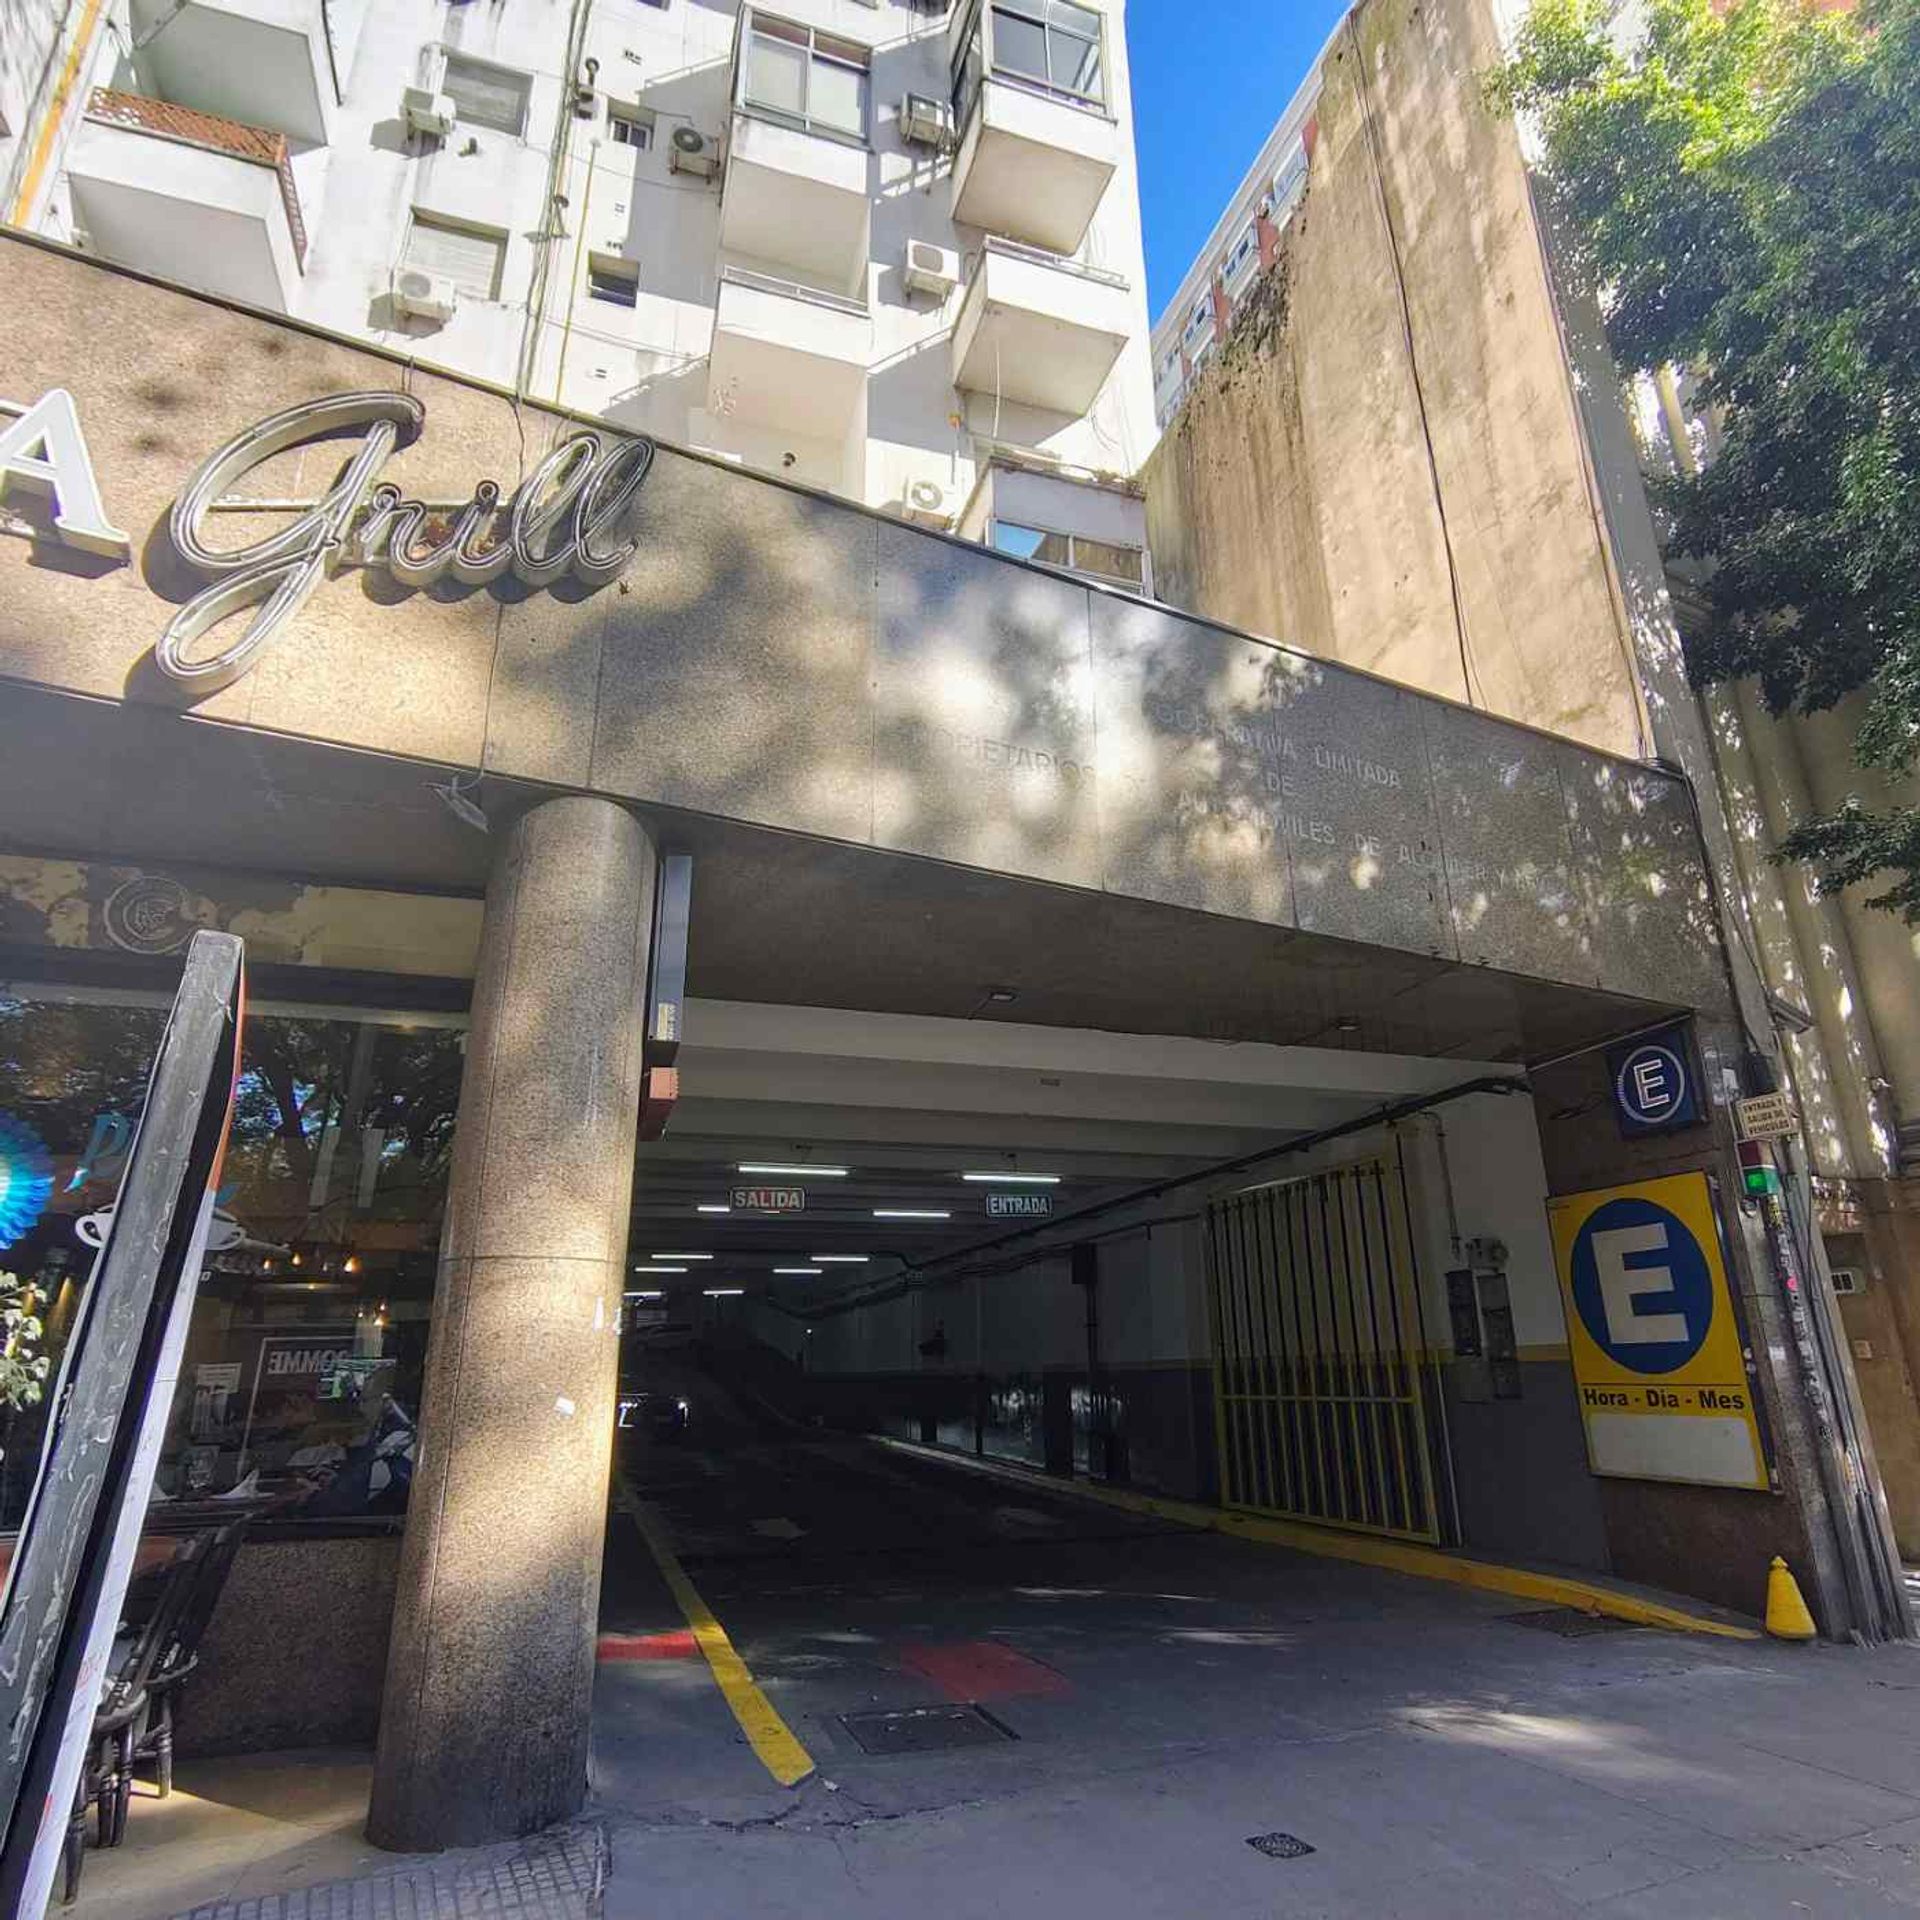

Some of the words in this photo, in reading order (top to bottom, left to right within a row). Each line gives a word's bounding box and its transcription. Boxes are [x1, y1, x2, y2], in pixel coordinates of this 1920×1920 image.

[155, 391, 655, 680] Grill
[1315, 747, 1401, 789] LIMITADA
[1634, 1059, 1669, 1110] E
[735, 1190, 800, 1209] SALIDA
[989, 1196, 1048, 1214] ENTRADA
[1591, 1222, 1690, 1345] E
[1583, 1388, 1628, 1406] Hora
[1646, 1389, 1680, 1408] Dia
[1698, 1390, 1744, 1410] Mes
